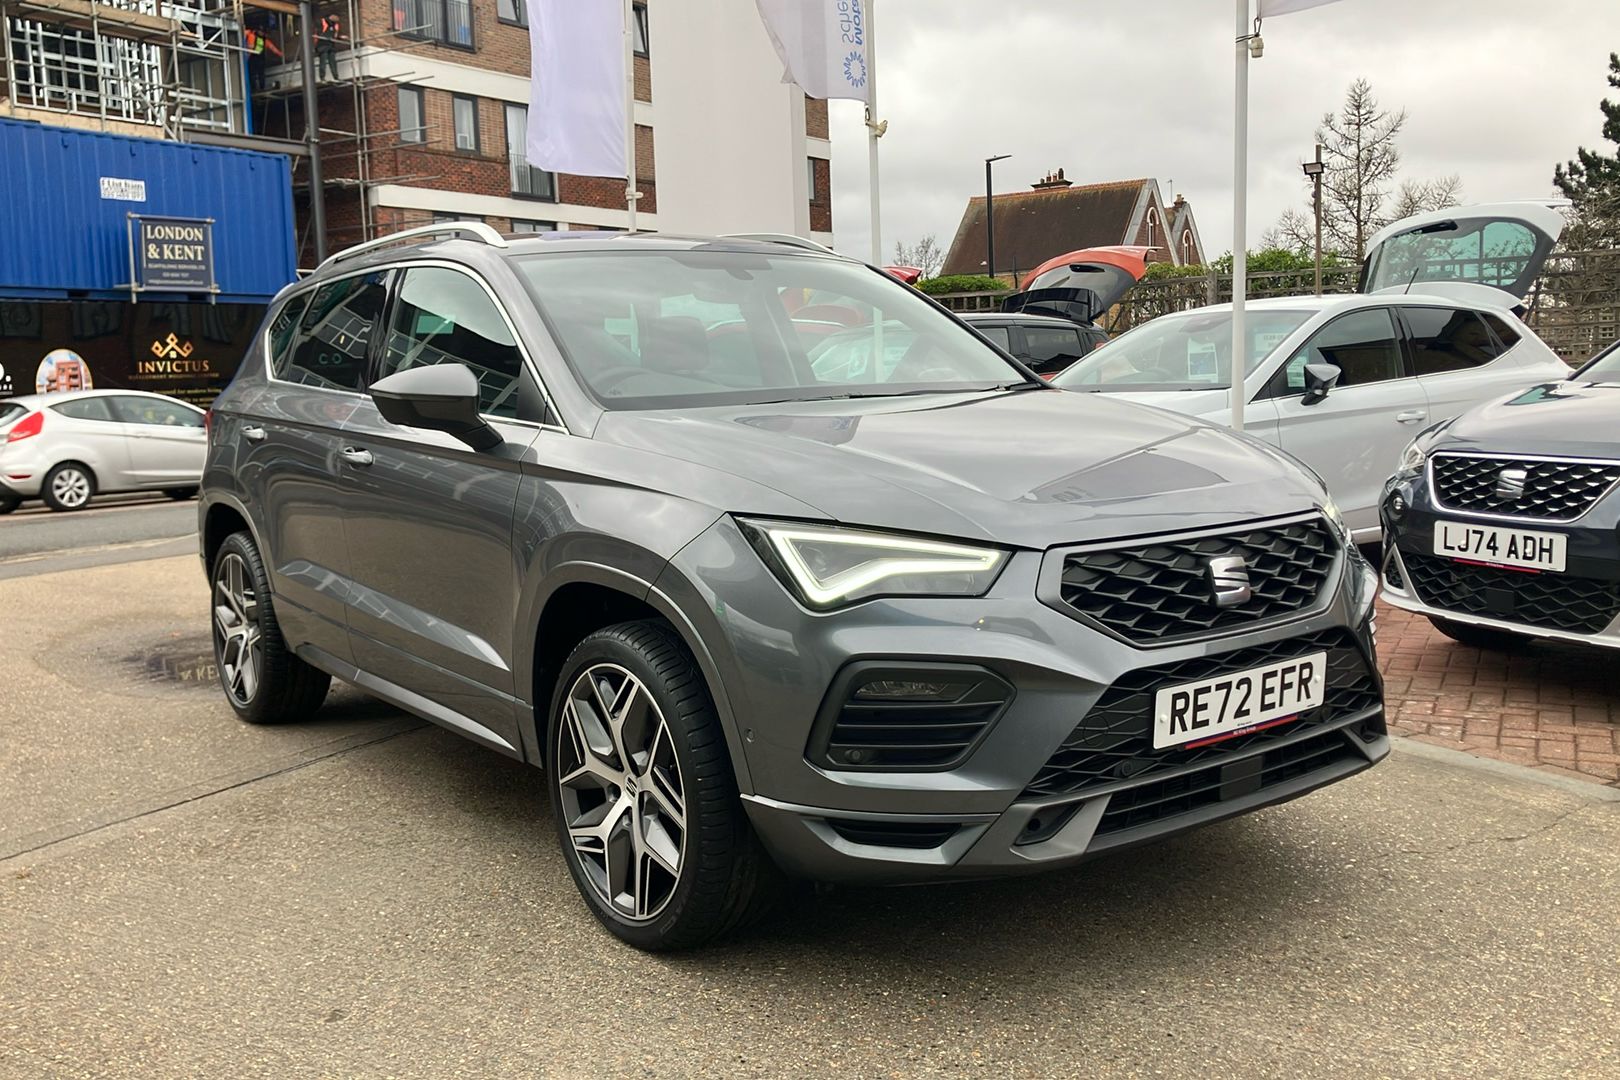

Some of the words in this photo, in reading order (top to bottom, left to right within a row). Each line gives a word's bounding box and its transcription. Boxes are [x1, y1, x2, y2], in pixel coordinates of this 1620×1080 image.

[147, 225, 203, 241] LONDON
[148, 243, 160, 259] &
[163, 244, 205, 260] KENT
[138, 360, 209, 373] INVICTUS
[1443, 526, 1499, 556] LJ74
[1506, 534, 1554, 564] ADH
[1169, 677, 1252, 735] RE72
[1260, 661, 1314, 713] EFR
